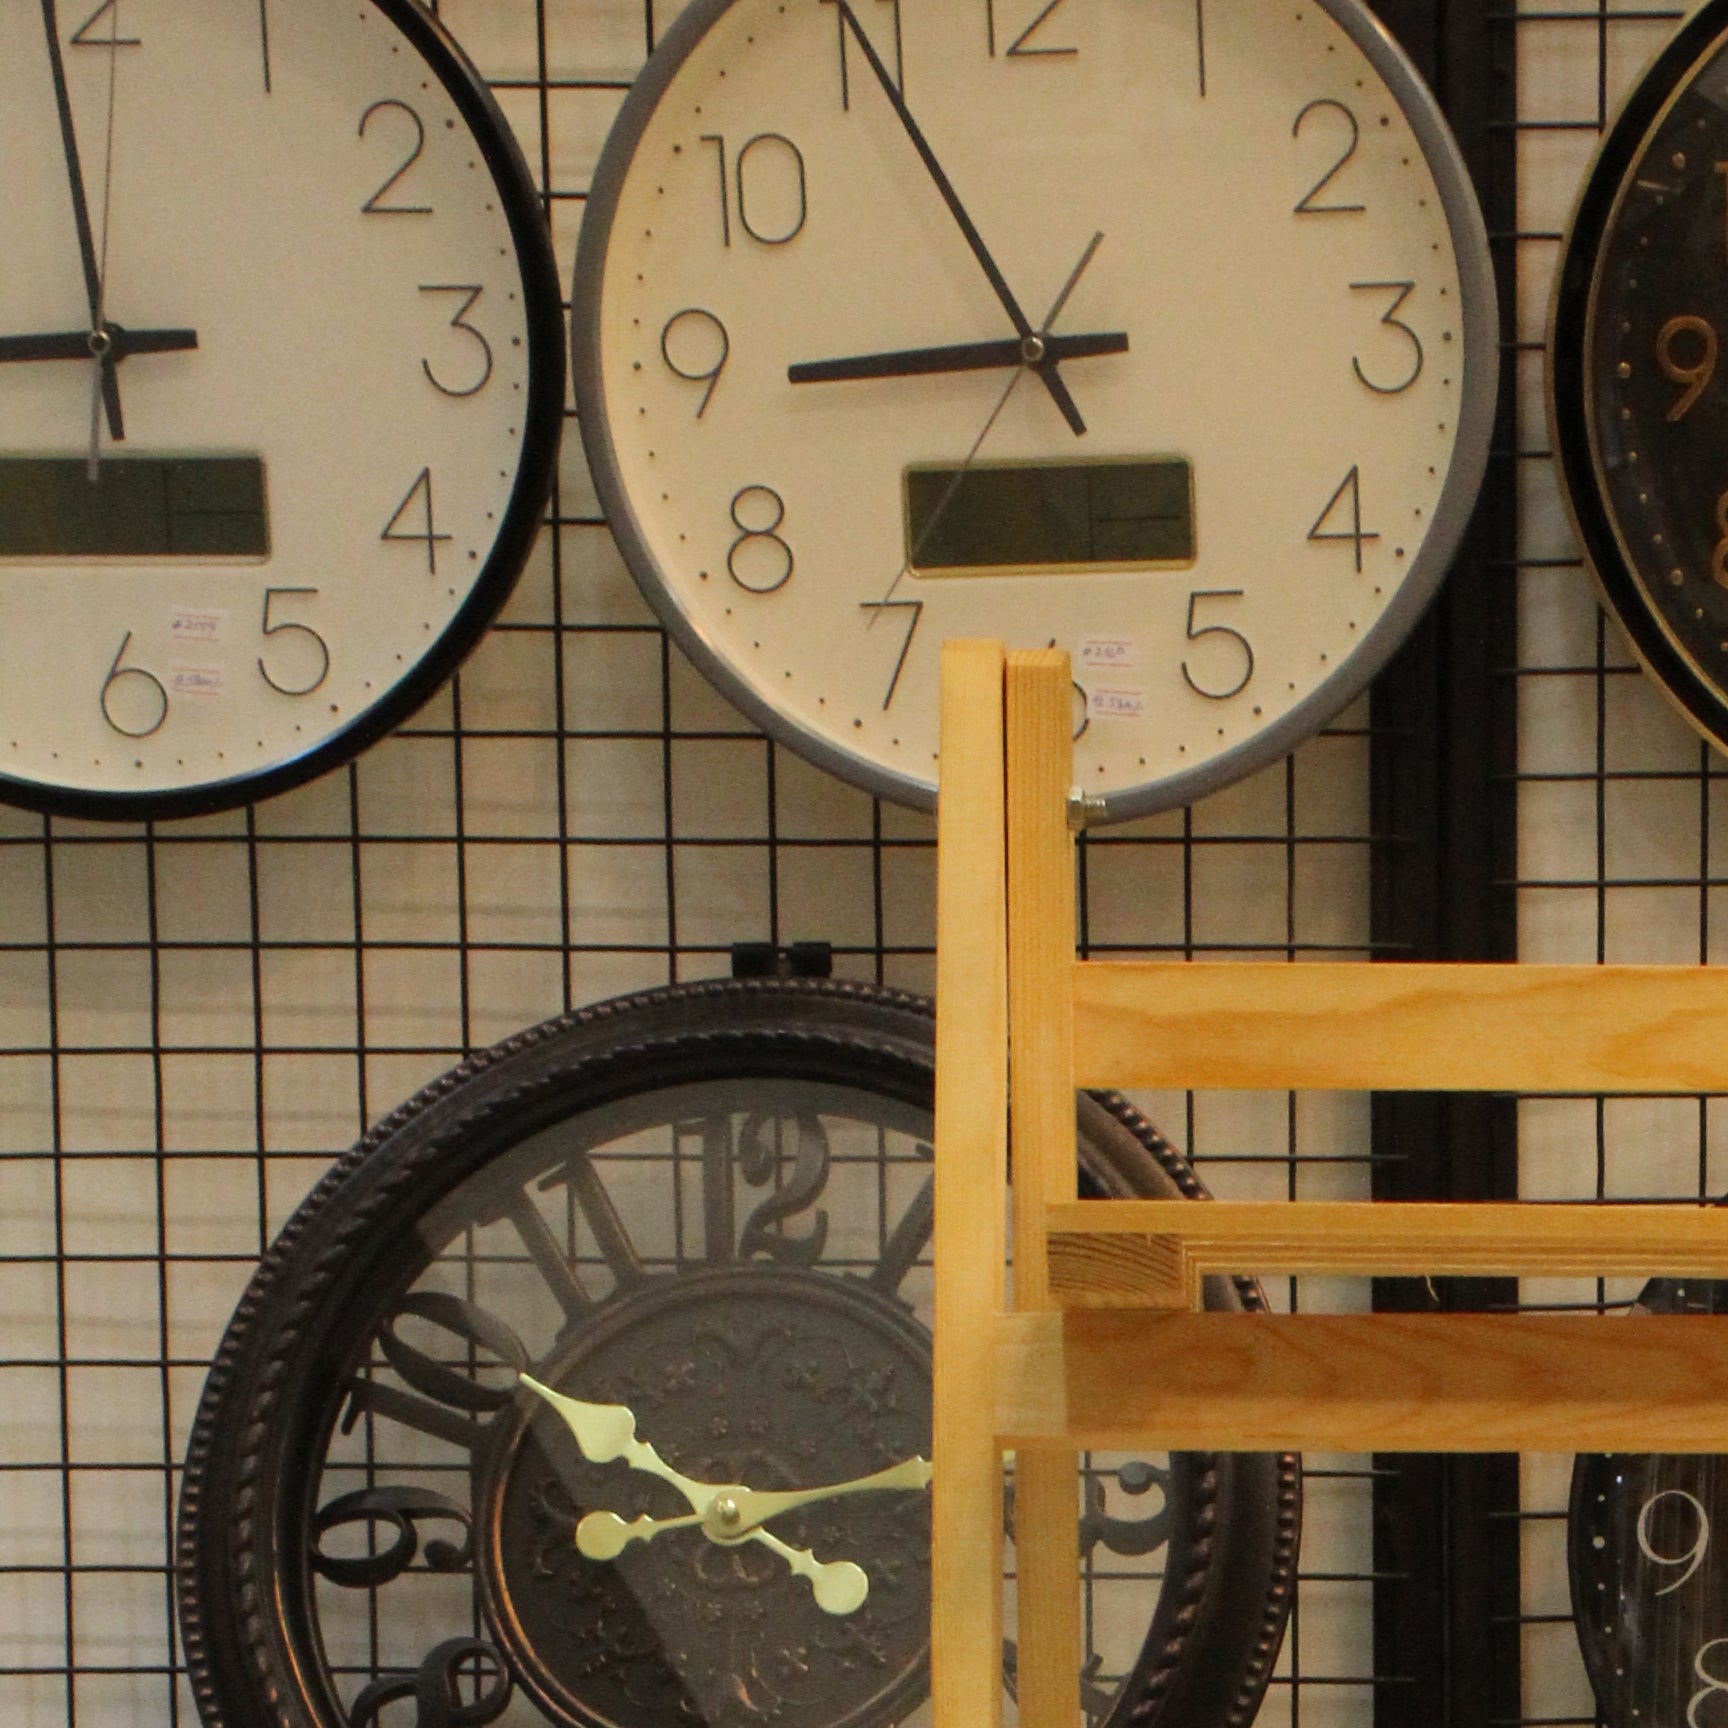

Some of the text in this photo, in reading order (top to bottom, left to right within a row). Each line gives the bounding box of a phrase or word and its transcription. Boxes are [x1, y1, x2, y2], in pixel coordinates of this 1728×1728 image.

[358, 98, 434, 215] 2
[700, 132, 807, 249] 10
[1291, 98, 1367, 214] 2
[418, 284, 493, 399] 3
[660, 308, 730, 420] 9
[1348, 281, 1424, 395] 3
[1655, 314, 1719, 425] 9
[380, 465, 454, 576] 4
[726, 484, 794, 594] 8
[1306, 464, 1381, 575] 4
[100, 629, 169, 739] 6
[257, 586, 331, 698] 5
[858, 600, 924, 712] 7
[1180, 589, 1255, 701] 5
[674, 1108, 831, 1270] 12
[1635, 1489, 1711, 1597] 9
